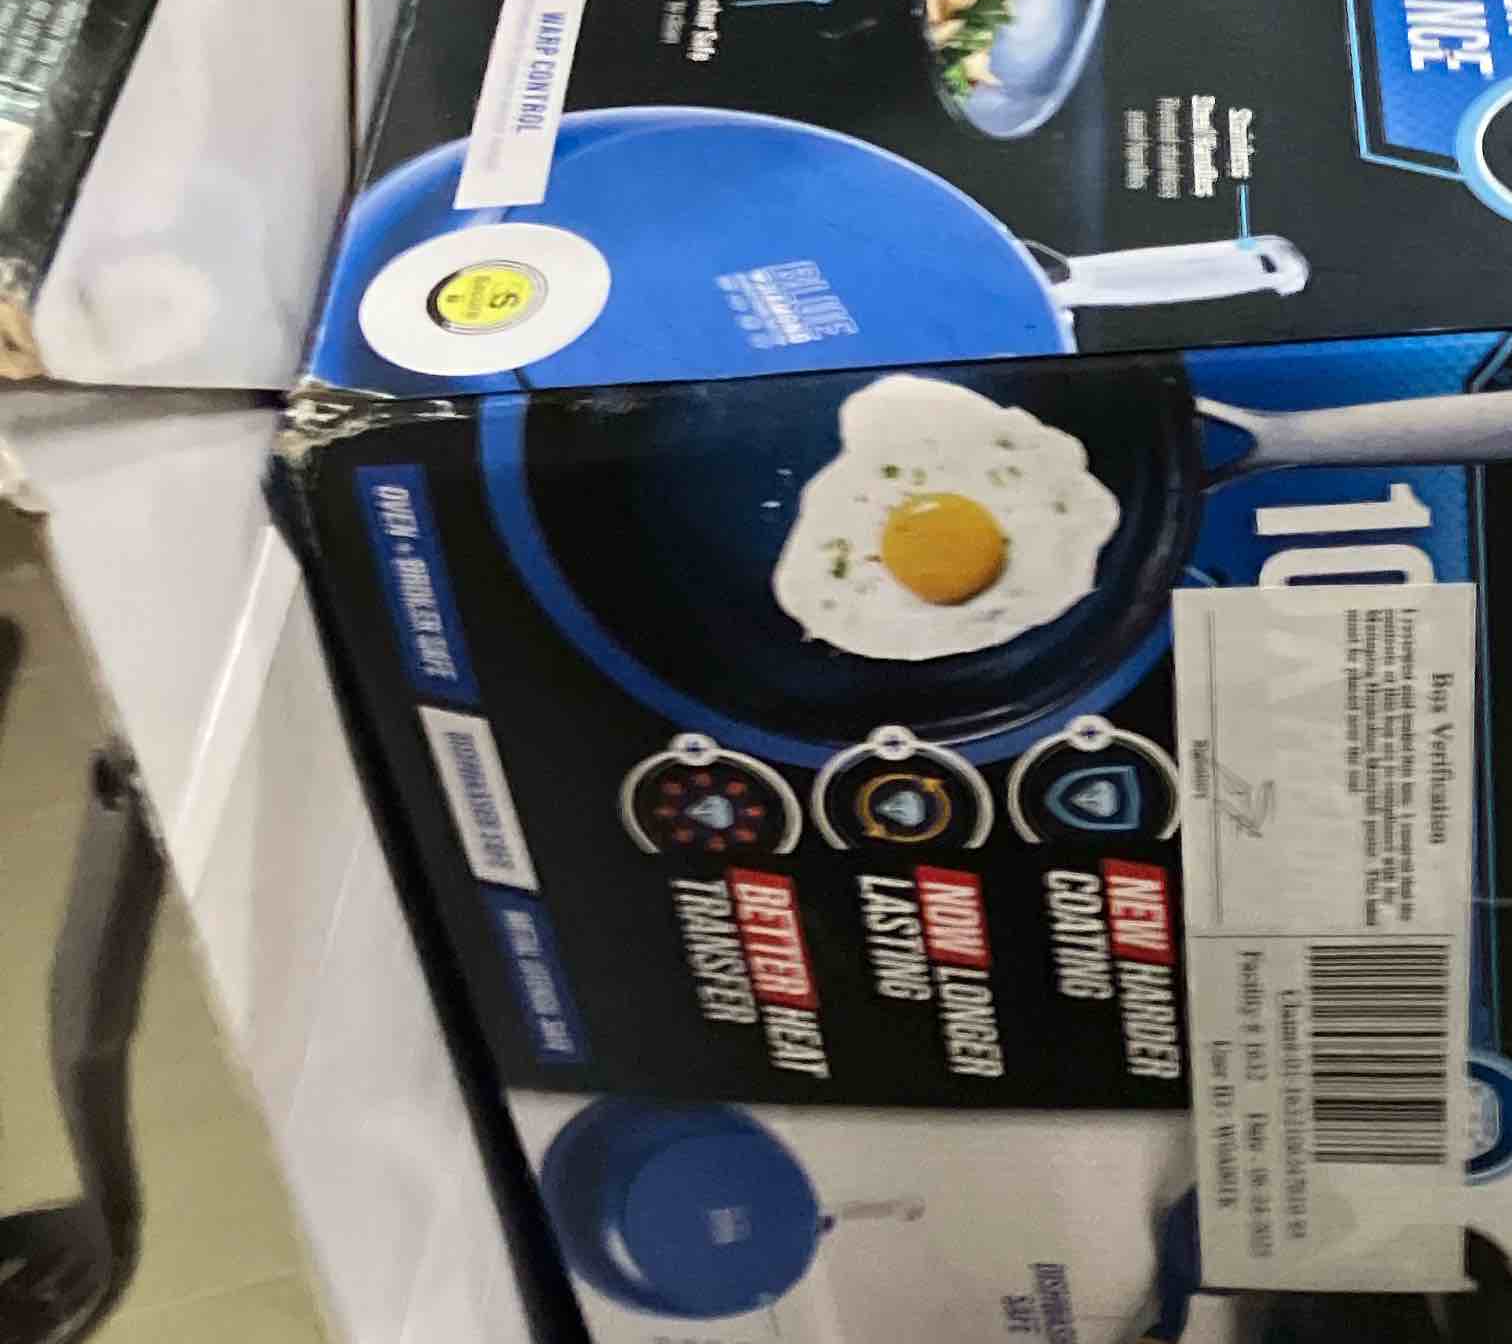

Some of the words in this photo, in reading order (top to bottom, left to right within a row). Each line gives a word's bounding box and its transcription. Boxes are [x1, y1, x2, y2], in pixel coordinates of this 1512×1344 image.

[535, 11, 567, 55] WARP
[515, 60, 556, 133] CONTROL
[374, 485, 419, 536] OVEN
[1428, 721, 1457, 845] Verification
[671, 878, 757, 1025] TRANSFER
[733, 882, 816, 997] BETTER
[856, 874, 931, 1001] LASTING
[922, 881, 988, 959] NOW
[1045, 869, 1111, 1000] COATING
[1107, 874, 1171, 952] NEW
[758, 1005, 830, 1079] HEAT
[935, 967, 1004, 1077] LONGER
[1115, 960, 1181, 1079] HARDER
